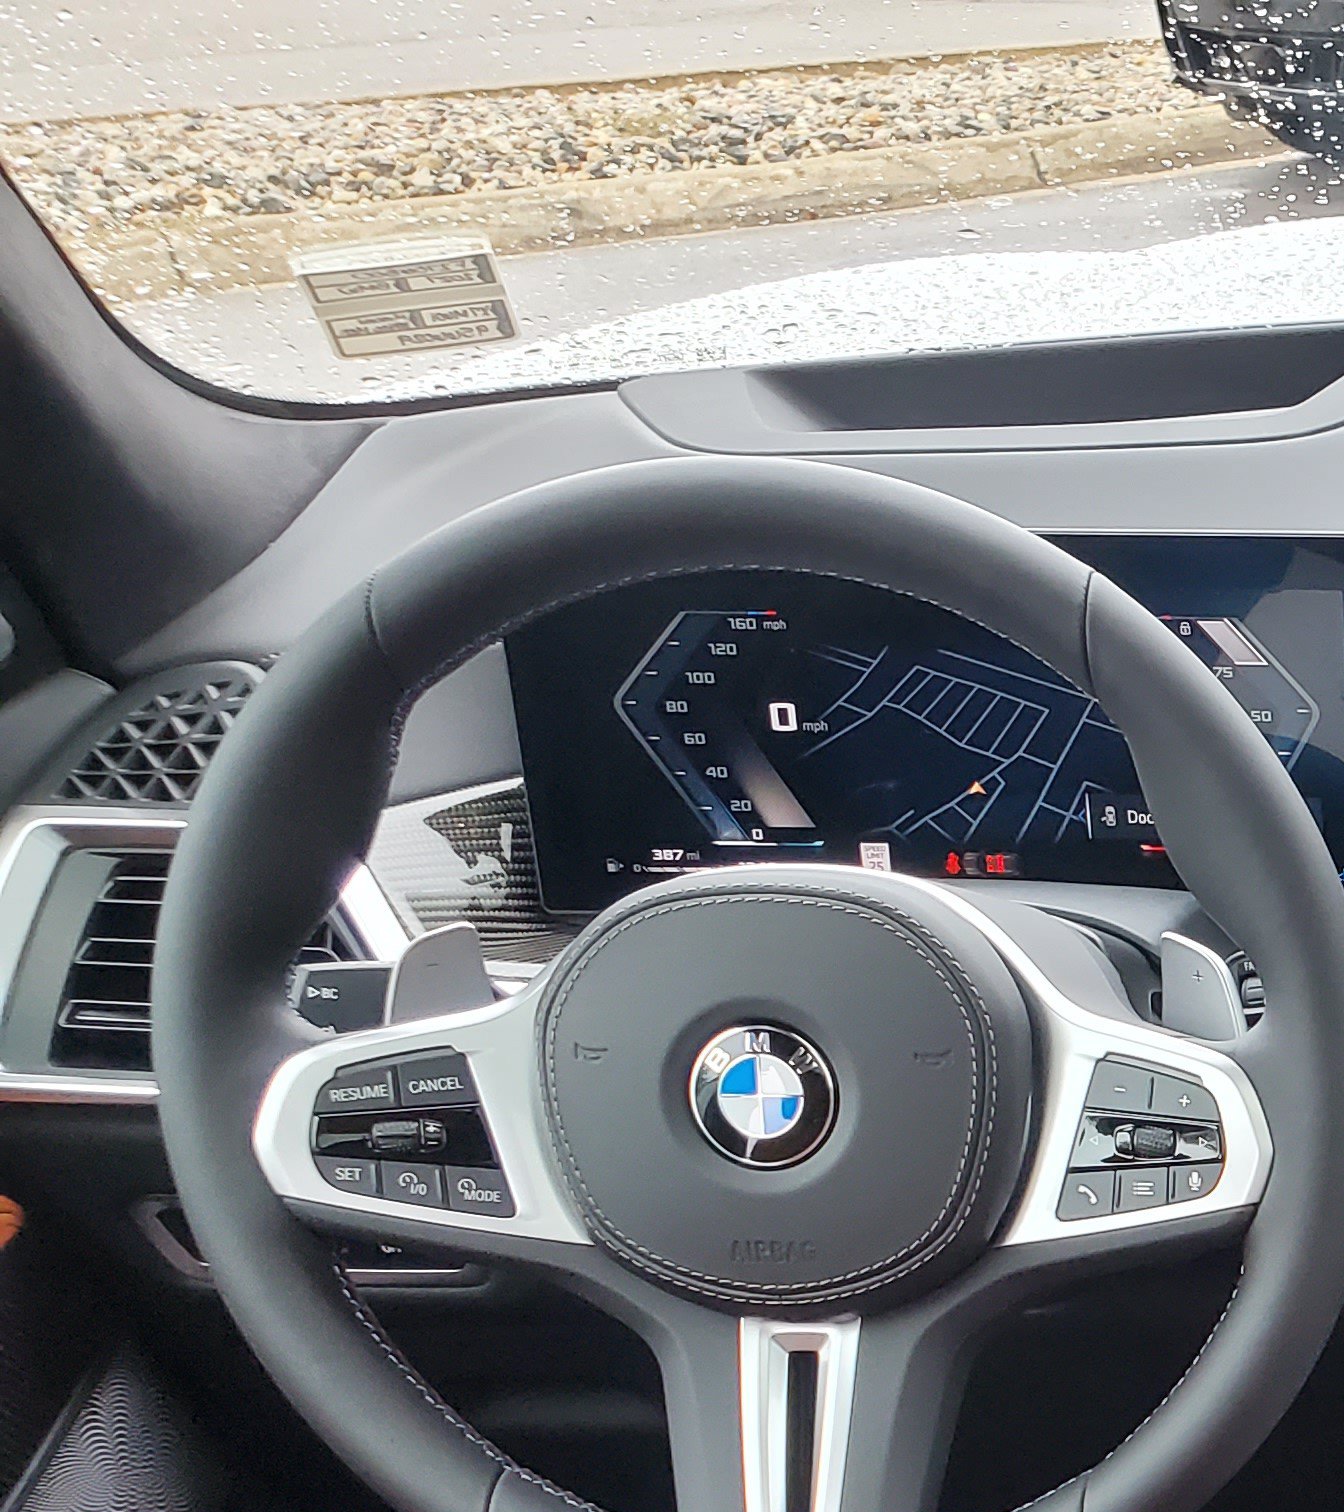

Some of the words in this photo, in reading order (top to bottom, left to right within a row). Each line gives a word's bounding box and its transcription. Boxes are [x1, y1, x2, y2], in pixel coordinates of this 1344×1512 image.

[727, 617, 757, 630] 160
[763, 619, 787, 631] mph
[707, 643, 738, 656] 120
[685, 672, 716, 685] 100
[1212, 666, 1233, 678] 75
[665, 700, 688, 713] 80
[768, 703, 798, 732] 0
[802, 721, 829, 733] mph
[1251, 711, 1272, 722] 50
[684, 733, 706, 745] 60
[705, 767, 728, 778] 40
[730, 800, 752, 812] 20
[752, 828, 764, 840] 0
[651, 849, 684, 861] 387
[703, 1031, 819, 1075] BMW
[408, 1076, 464, 1094] CANCEL
[329, 1083, 390, 1102] RESUME
[335, 1167, 362, 1181] SET
[463, 1190, 502, 1203] MODE
[730, 1240, 817, 1262] AIRBAG
